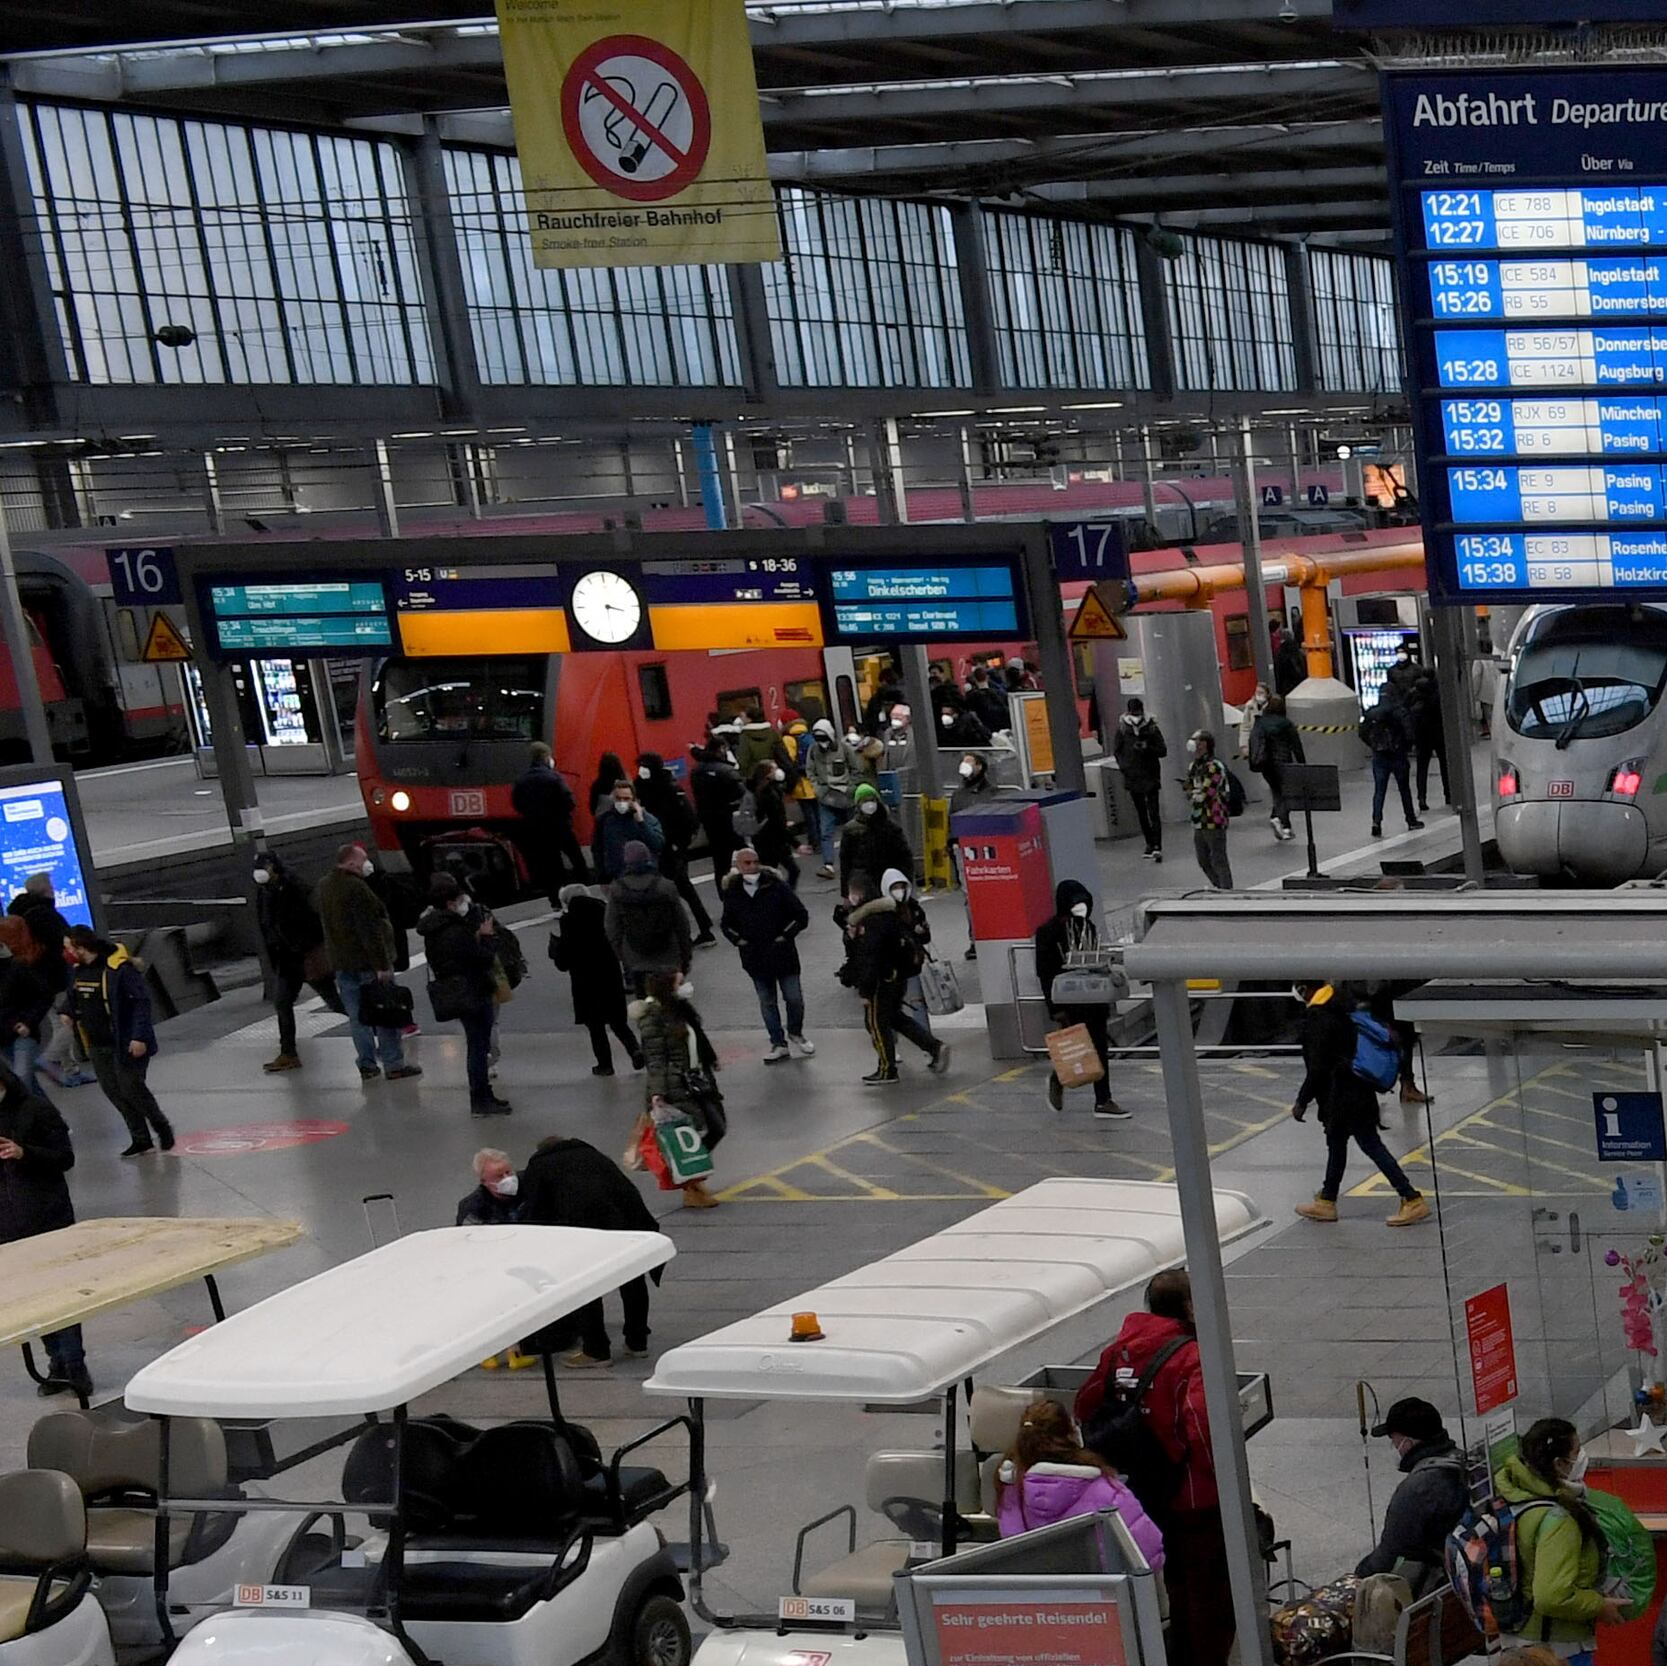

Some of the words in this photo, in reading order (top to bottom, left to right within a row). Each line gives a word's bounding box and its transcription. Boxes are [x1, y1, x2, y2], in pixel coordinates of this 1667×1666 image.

[1413, 93, 1537, 127] Abfahrt
[1424, 160, 1449, 174] Zeit
[1453, 161, 1516, 174] Time/Temps
[1581, 154, 1614, 171] Über
[1618, 159, 1633, 170] Via
[1427, 194, 1481, 215] 12:21
[537, 213, 640, 231] Rauchfreier
[647, 209, 722, 227] Bahnhof
[610, 237, 647, 248] Station
[1430, 223, 1483, 244] 12:27
[1433, 263, 1488, 285] 15:19
[1437, 292, 1491, 312] 15:26
[1443, 361, 1497, 381] 15:28
[1446, 402, 1500, 422] 15:29
[1449, 430, 1503, 449] 15:32
[1452, 470, 1507, 490] 15:34
[1068, 525, 1111, 567] 17
[1460, 537, 1513, 557] 15:34
[114, 550, 164, 594] 16
[405, 568, 431, 583] 5-15
[762, 559, 796, 574] 18-36
[1462, 563, 1516, 583] 15:38
[869, 585, 947, 597] Dinkelscherben
[966, 866, 1011, 874] Fahrkarten
[267, 1590, 288, 1600] S&S
[292, 1592, 302, 1600] 11
[785, 1601, 806, 1614] DB
[809, 1603, 830, 1615] S&S
[833, 1606, 845, 1615] 06
[942, 1614, 973, 1626] Sehr
[978, 1614, 1033, 1628] geehrte
[1036, 1613, 1107, 1624] Reisende!
